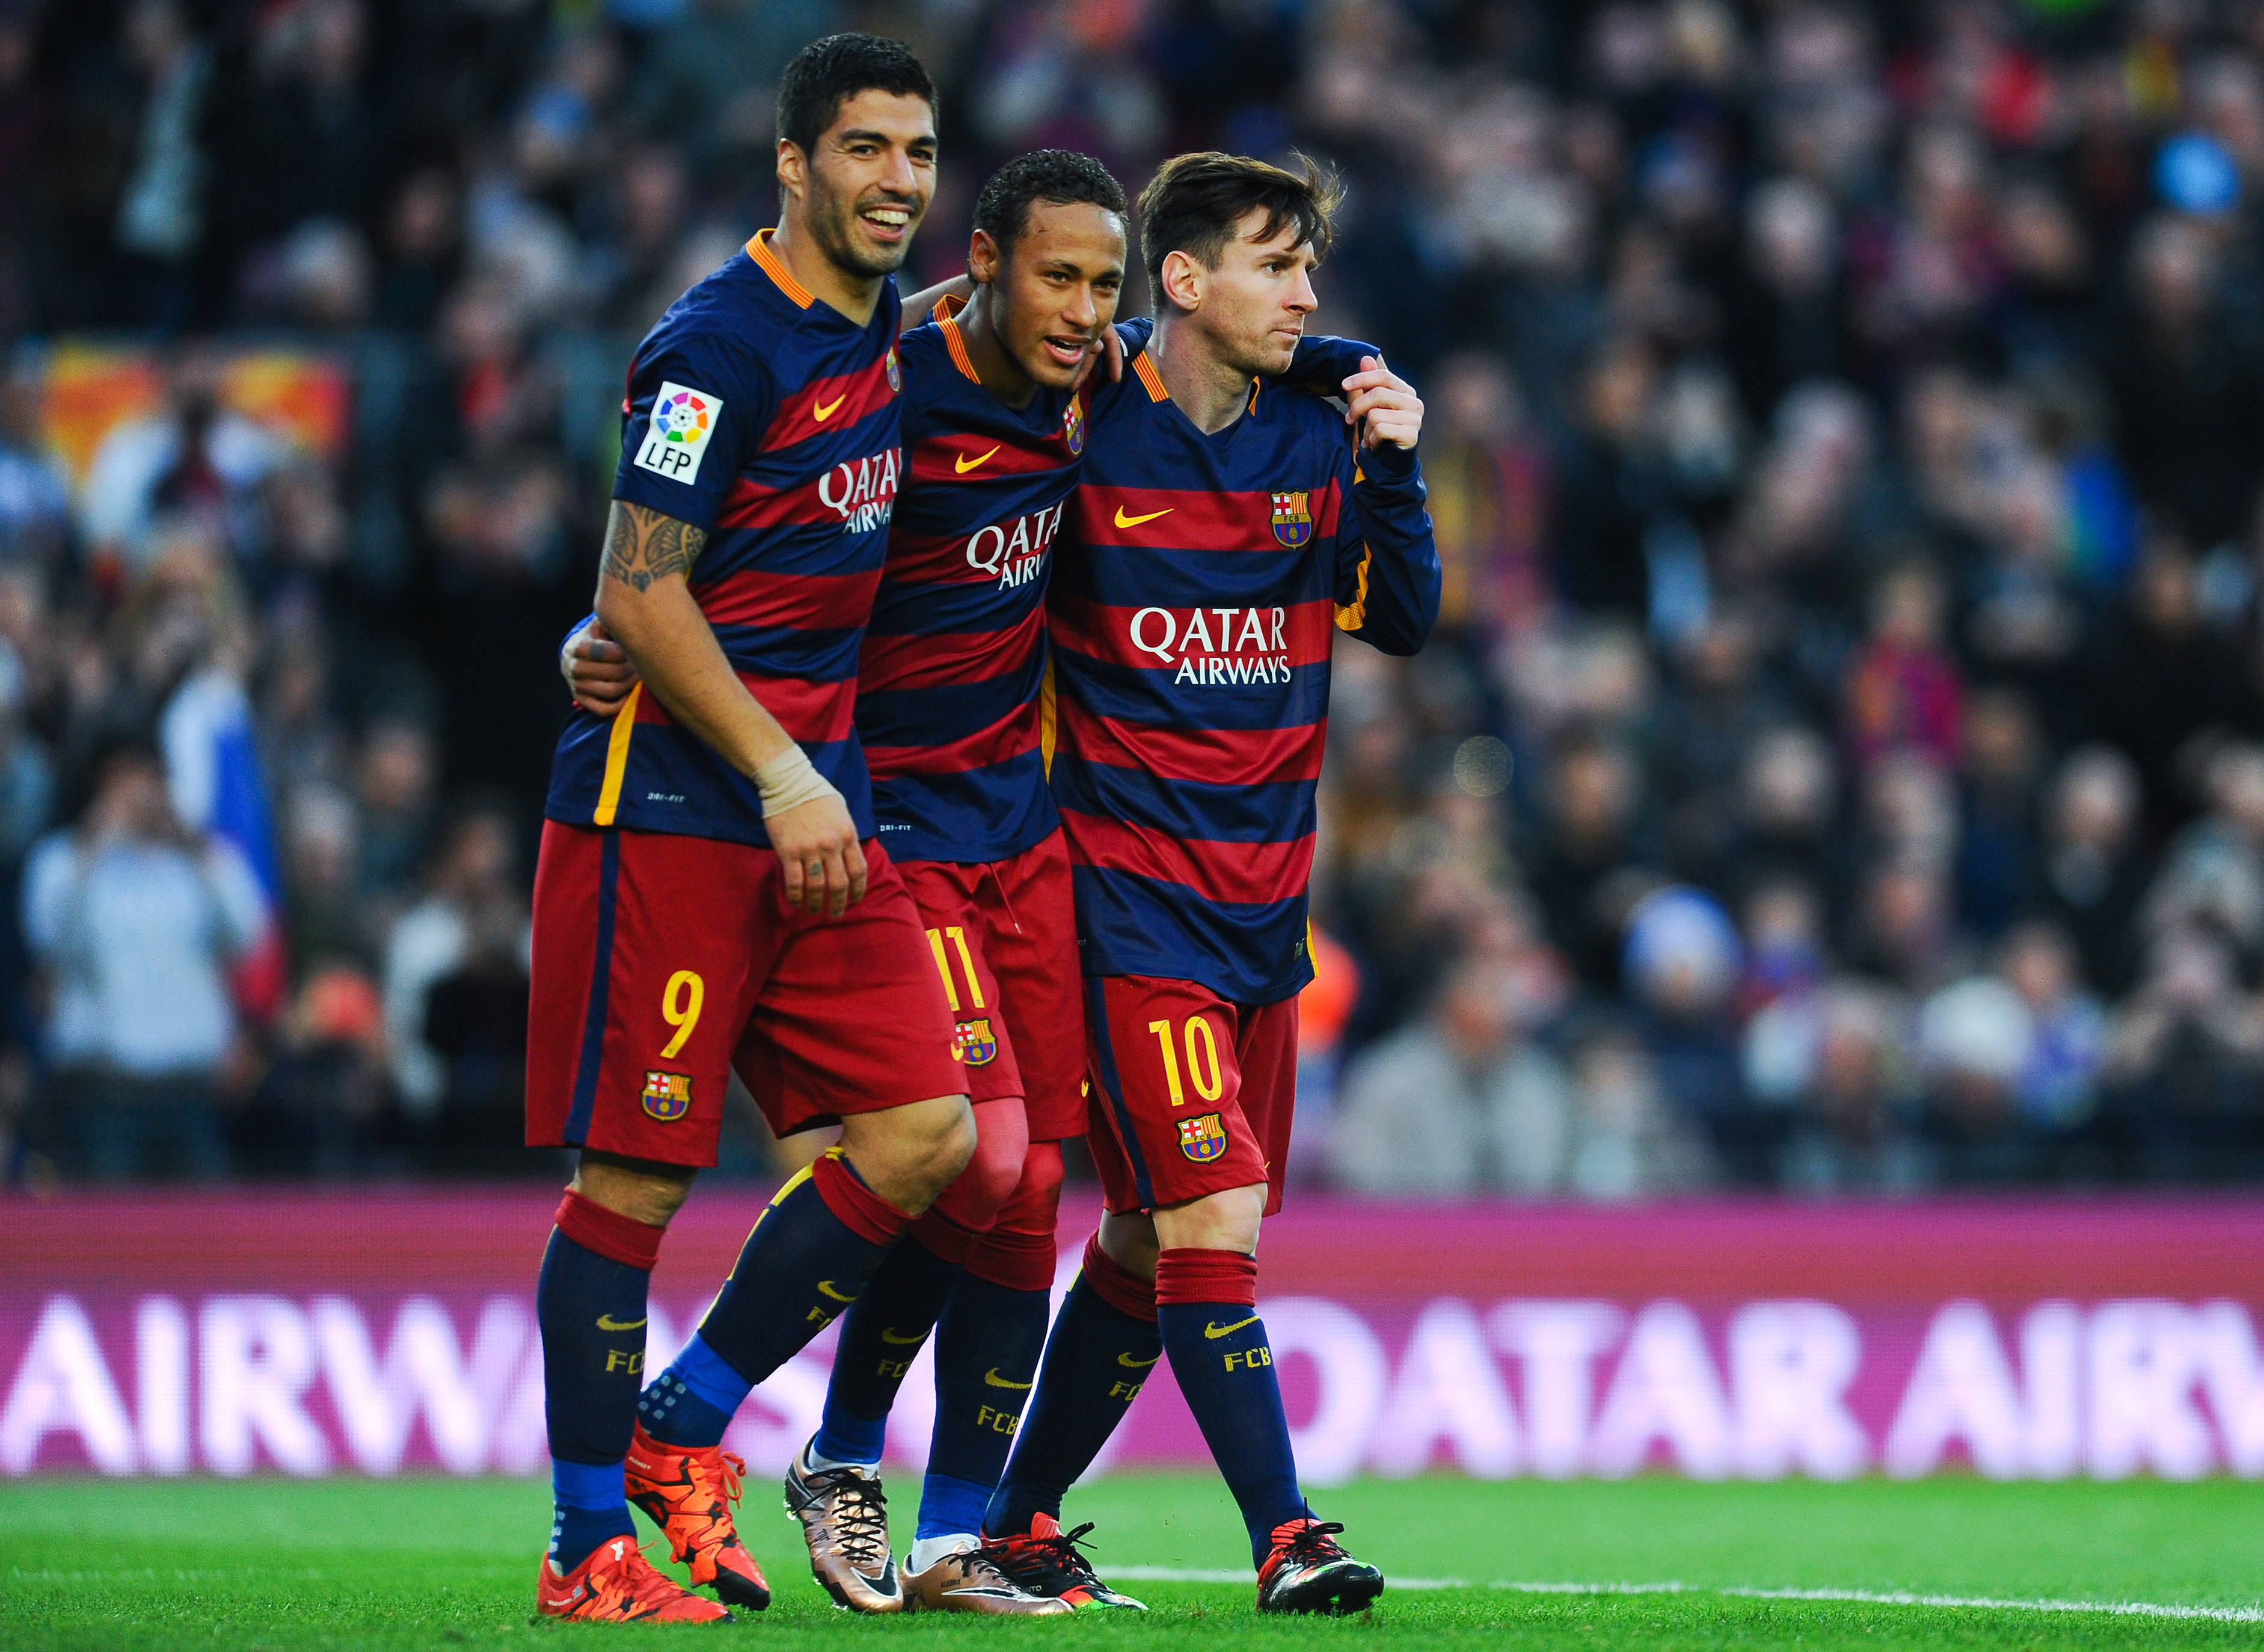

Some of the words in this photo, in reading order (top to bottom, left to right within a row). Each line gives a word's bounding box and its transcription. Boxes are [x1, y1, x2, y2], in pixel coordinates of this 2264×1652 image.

[645, 442, 691, 474] LFP
[818, 447, 903, 518] QATA
[966, 500, 1063, 575] QATA
[1130, 607, 1287, 663] QATAR
[1174, 655, 1291, 685] AIRWAYS
[647, 792, 686, 803] DRI-FIT
[925, 926, 986, 1011] 11
[660, 970, 704, 1059] 9
[1149, 1016, 1222, 1107] 10
[1194, 1133, 1212, 1142] FCB
[606, 1349, 645, 1374] FC
[877, 1359, 912, 1378] FC
[1224, 1347, 1271, 1371] FCB
[1109, 1381, 1143, 1401] FC
[977, 1405, 1020, 1435] FCB
